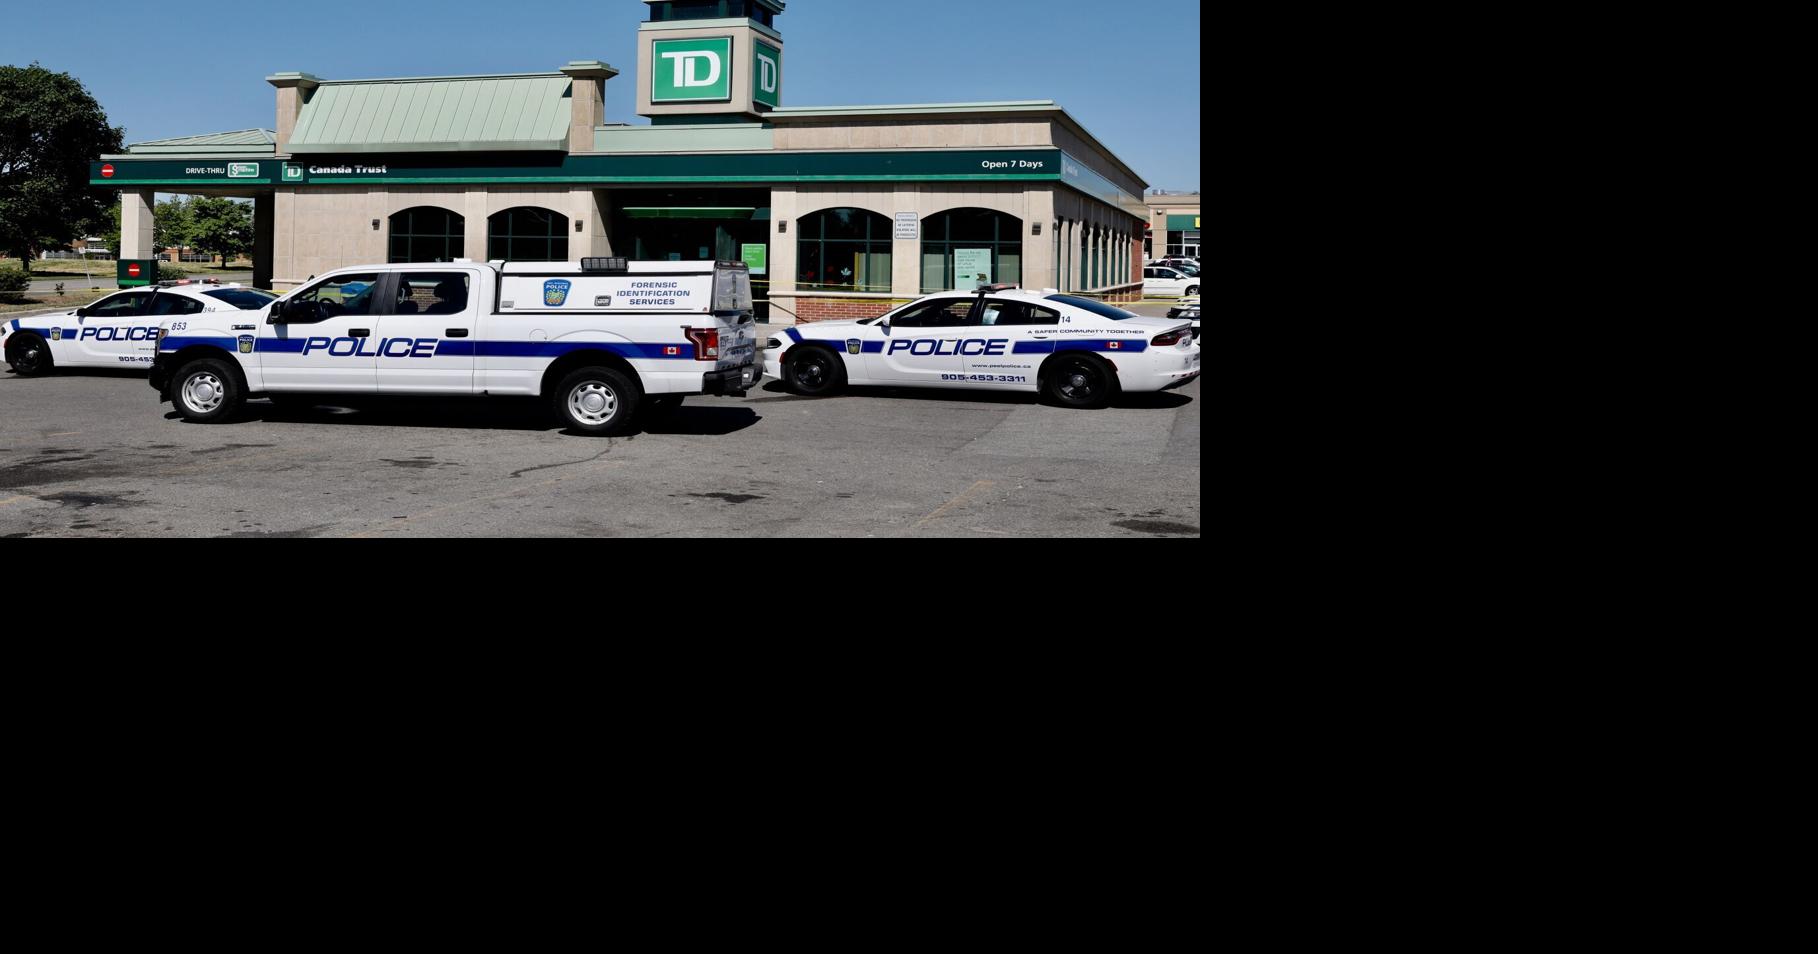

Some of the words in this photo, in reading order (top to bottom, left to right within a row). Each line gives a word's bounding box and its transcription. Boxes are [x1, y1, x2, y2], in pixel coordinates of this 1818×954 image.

[661, 50, 721, 88] TD
[757, 52, 777, 94] TD
[284, 165, 301, 178] TD
[308, 164, 353, 174] Canada
[354, 164, 387, 174] Trust
[981, 160, 1008, 170] Open
[1010, 160, 1017, 168] 7
[1019, 160, 1043, 169] Days
[630, 281, 678, 289] FORENSIC
[1061, 315, 1071, 323] 14
[171, 321, 187, 331] 853
[302, 336, 439, 358] POLICE
[887, 338, 1009, 356] POLICE
[941, 374, 1026, 382] 905-453-3311
